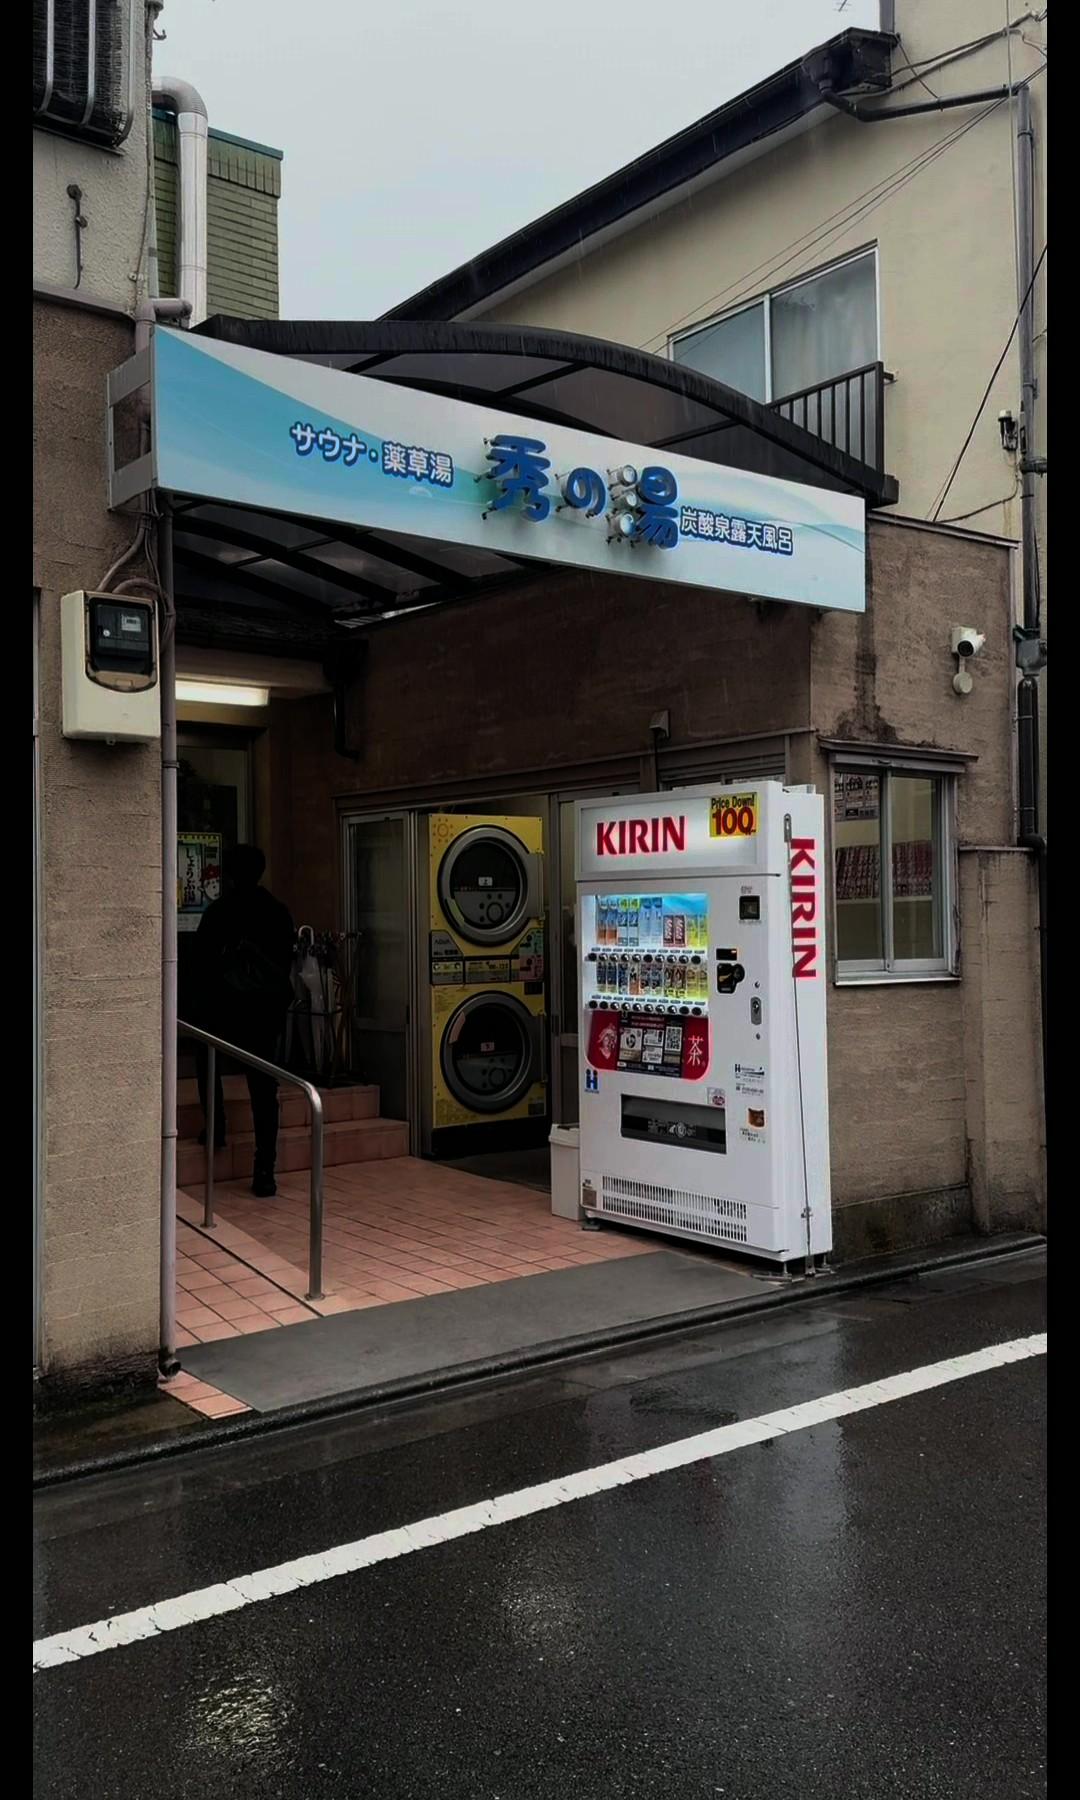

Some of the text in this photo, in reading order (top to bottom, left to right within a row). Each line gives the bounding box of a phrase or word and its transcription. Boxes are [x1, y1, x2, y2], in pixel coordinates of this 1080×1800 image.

[289, 421, 454, 488] サウナ・薬草湯
[486, 434, 679, 550] 秀の湯
[680, 507, 794, 556] 炭酸泉露天風呂
[711, 797, 730, 809] Price
[597, 816, 685, 855] KIRIN
[790, 838, 817, 978] KIRIN
[688, 1036, 705, 1065] 茶
